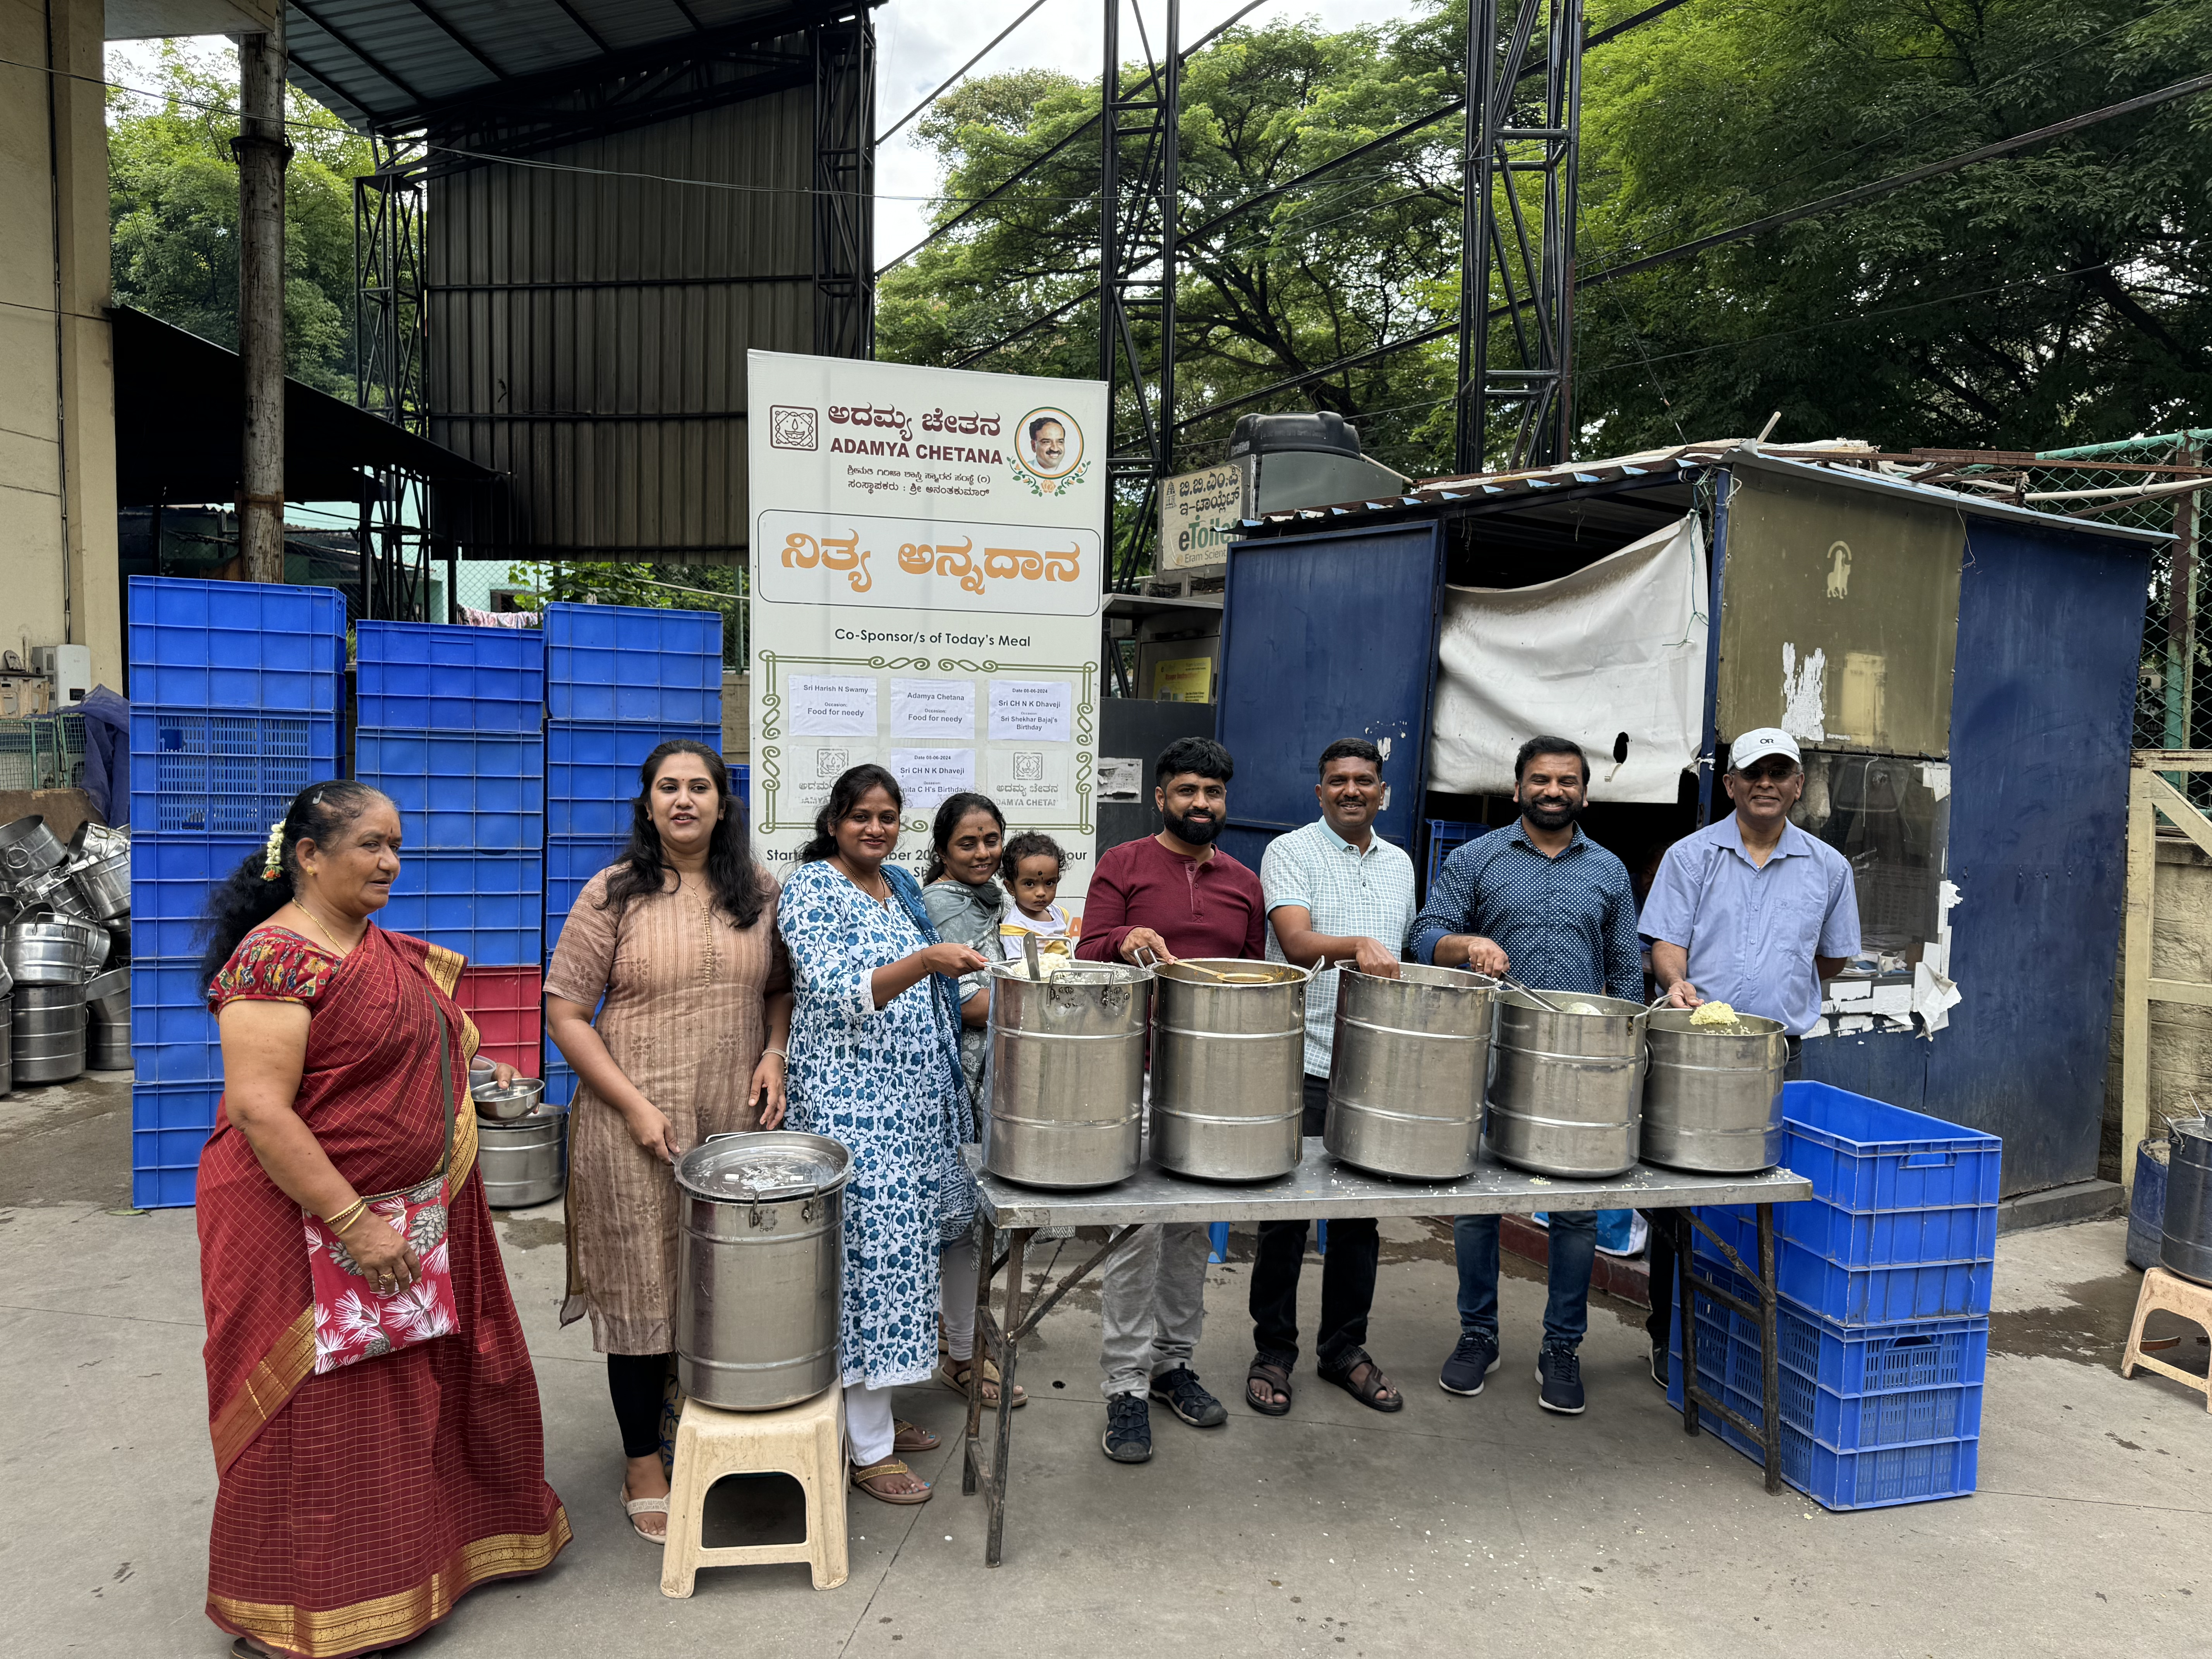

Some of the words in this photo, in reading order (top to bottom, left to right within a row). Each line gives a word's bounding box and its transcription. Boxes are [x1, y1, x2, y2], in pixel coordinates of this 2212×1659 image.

[828, 402, 913, 442] ಅದಮ್ಯ
[922, 408, 1000, 436] ಚೇತನ
[830, 438, 910, 458] ADAMYA
[916, 444, 1003, 464] CHETANA
[847, 465, 873, 475] ಶ್ರೀಮತಿ
[848, 479, 898, 495] ಸಂಸ್ಥಾಪಕರು
[909, 483, 921, 495] ಶ್ರೀ
[926, 485, 989, 496] ಅನಂತಕುಮಾರ್
[781, 529, 872, 593] ನಿತ್ಯ
[898, 535, 1080, 595] ಅನ್ನದಾನ
[1185, 553, 1202, 563] Eram
[1204, 549, 1226, 560] Scient
[835, 629, 925, 644] Co-Sponsor/s
[929, 632, 942, 643] of
[945, 633, 994, 647] Today's
[999, 635, 1030, 647] Meal
[907, 692, 935, 701] Adamya
[996, 783, 1027, 797] ಅದಮ್ಯ
